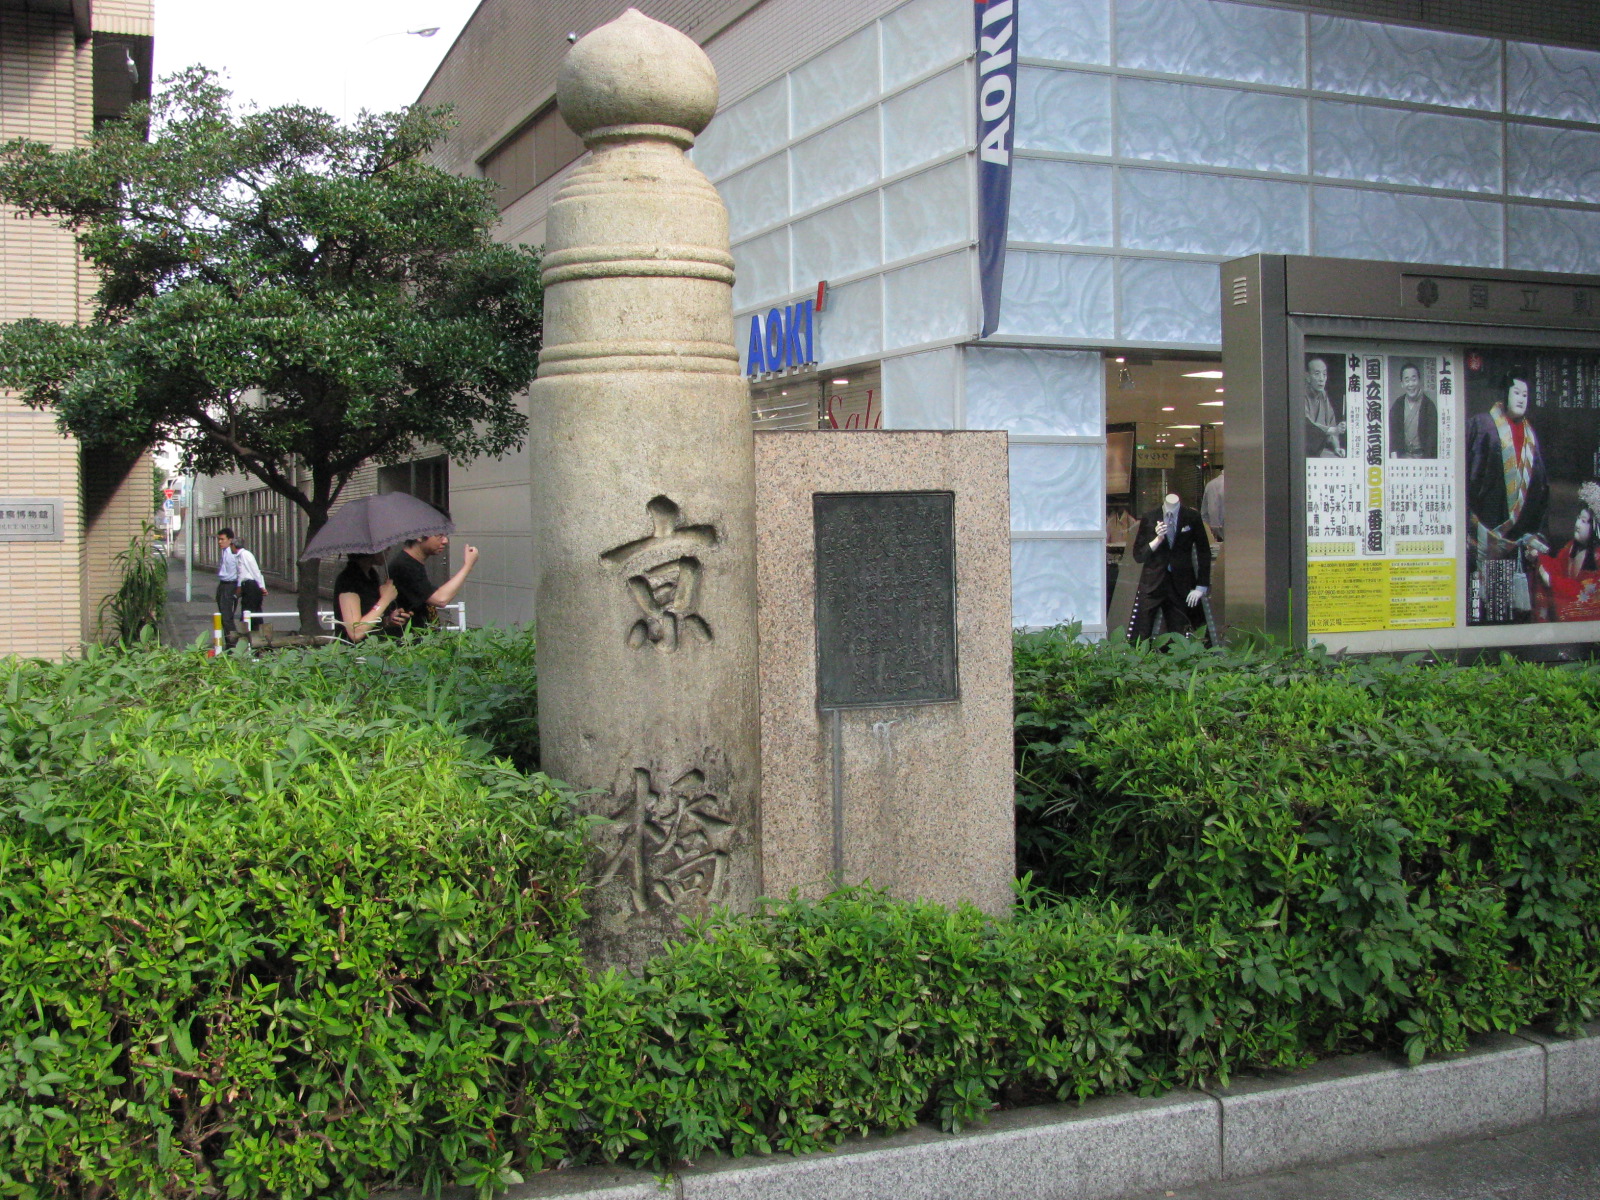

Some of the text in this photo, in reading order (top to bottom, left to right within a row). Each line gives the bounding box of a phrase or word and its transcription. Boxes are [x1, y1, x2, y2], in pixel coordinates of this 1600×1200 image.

[980, 0, 1013, 166] AOKI
[746, 300, 814, 376] AOKI
[1348, 353, 1361, 393] 中席
[1438, 357, 1452, 395] 上席
[596, 492, 734, 914] 京橋
